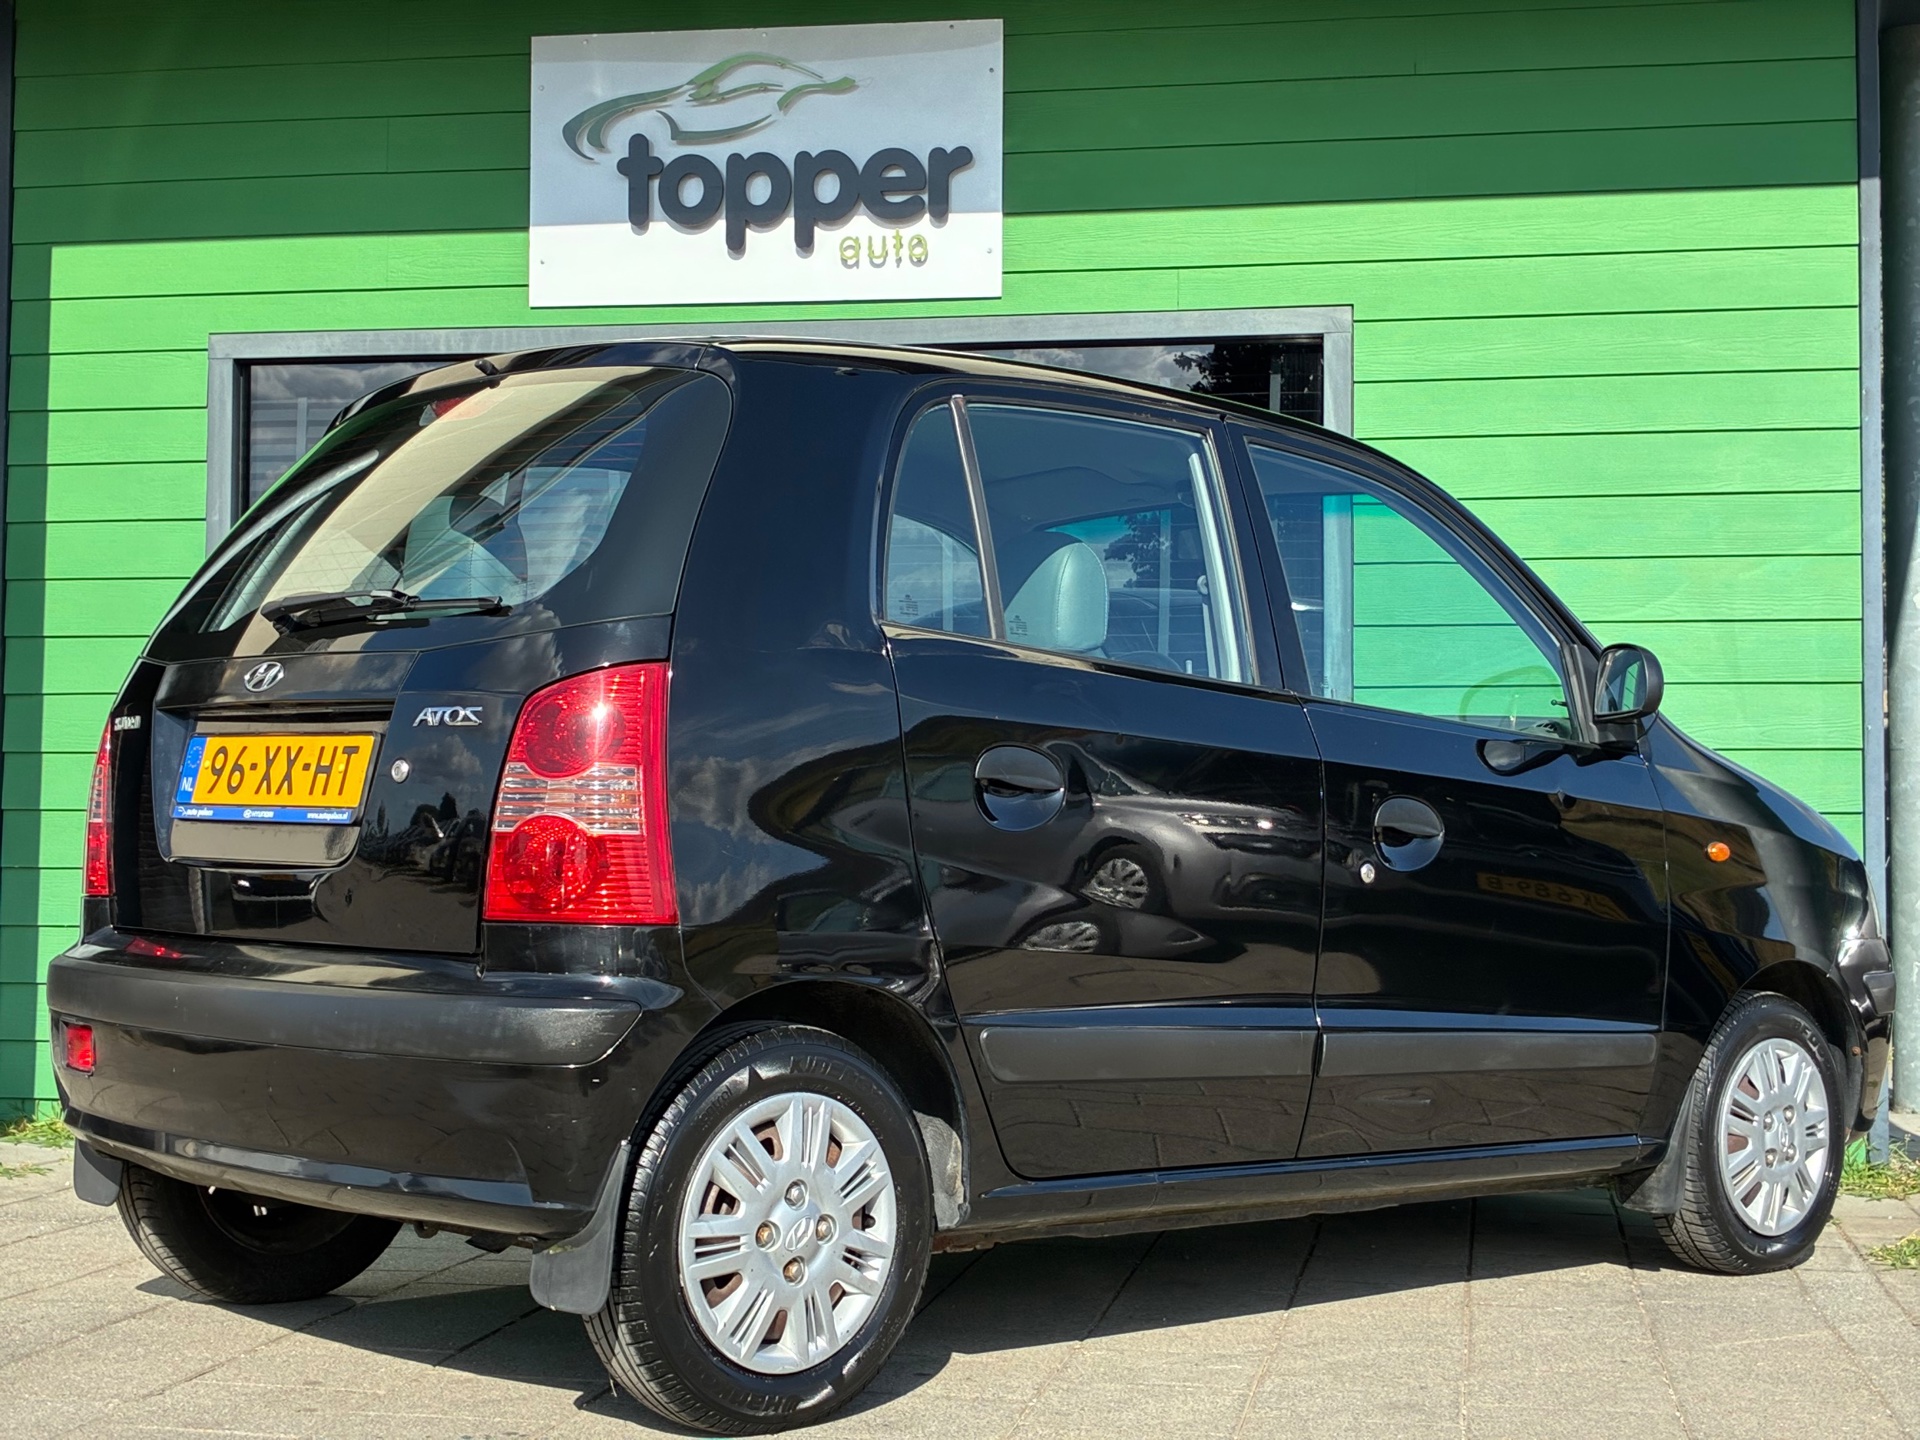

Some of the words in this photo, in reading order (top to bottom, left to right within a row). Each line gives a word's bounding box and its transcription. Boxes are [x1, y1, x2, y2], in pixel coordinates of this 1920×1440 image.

[616, 133, 973, 252] topper
[839, 228, 928, 261] auto
[412, 706, 483, 727] ATOS
[181, 777, 193, 792] NL
[207, 745, 360, 796] 96-XX-HT
